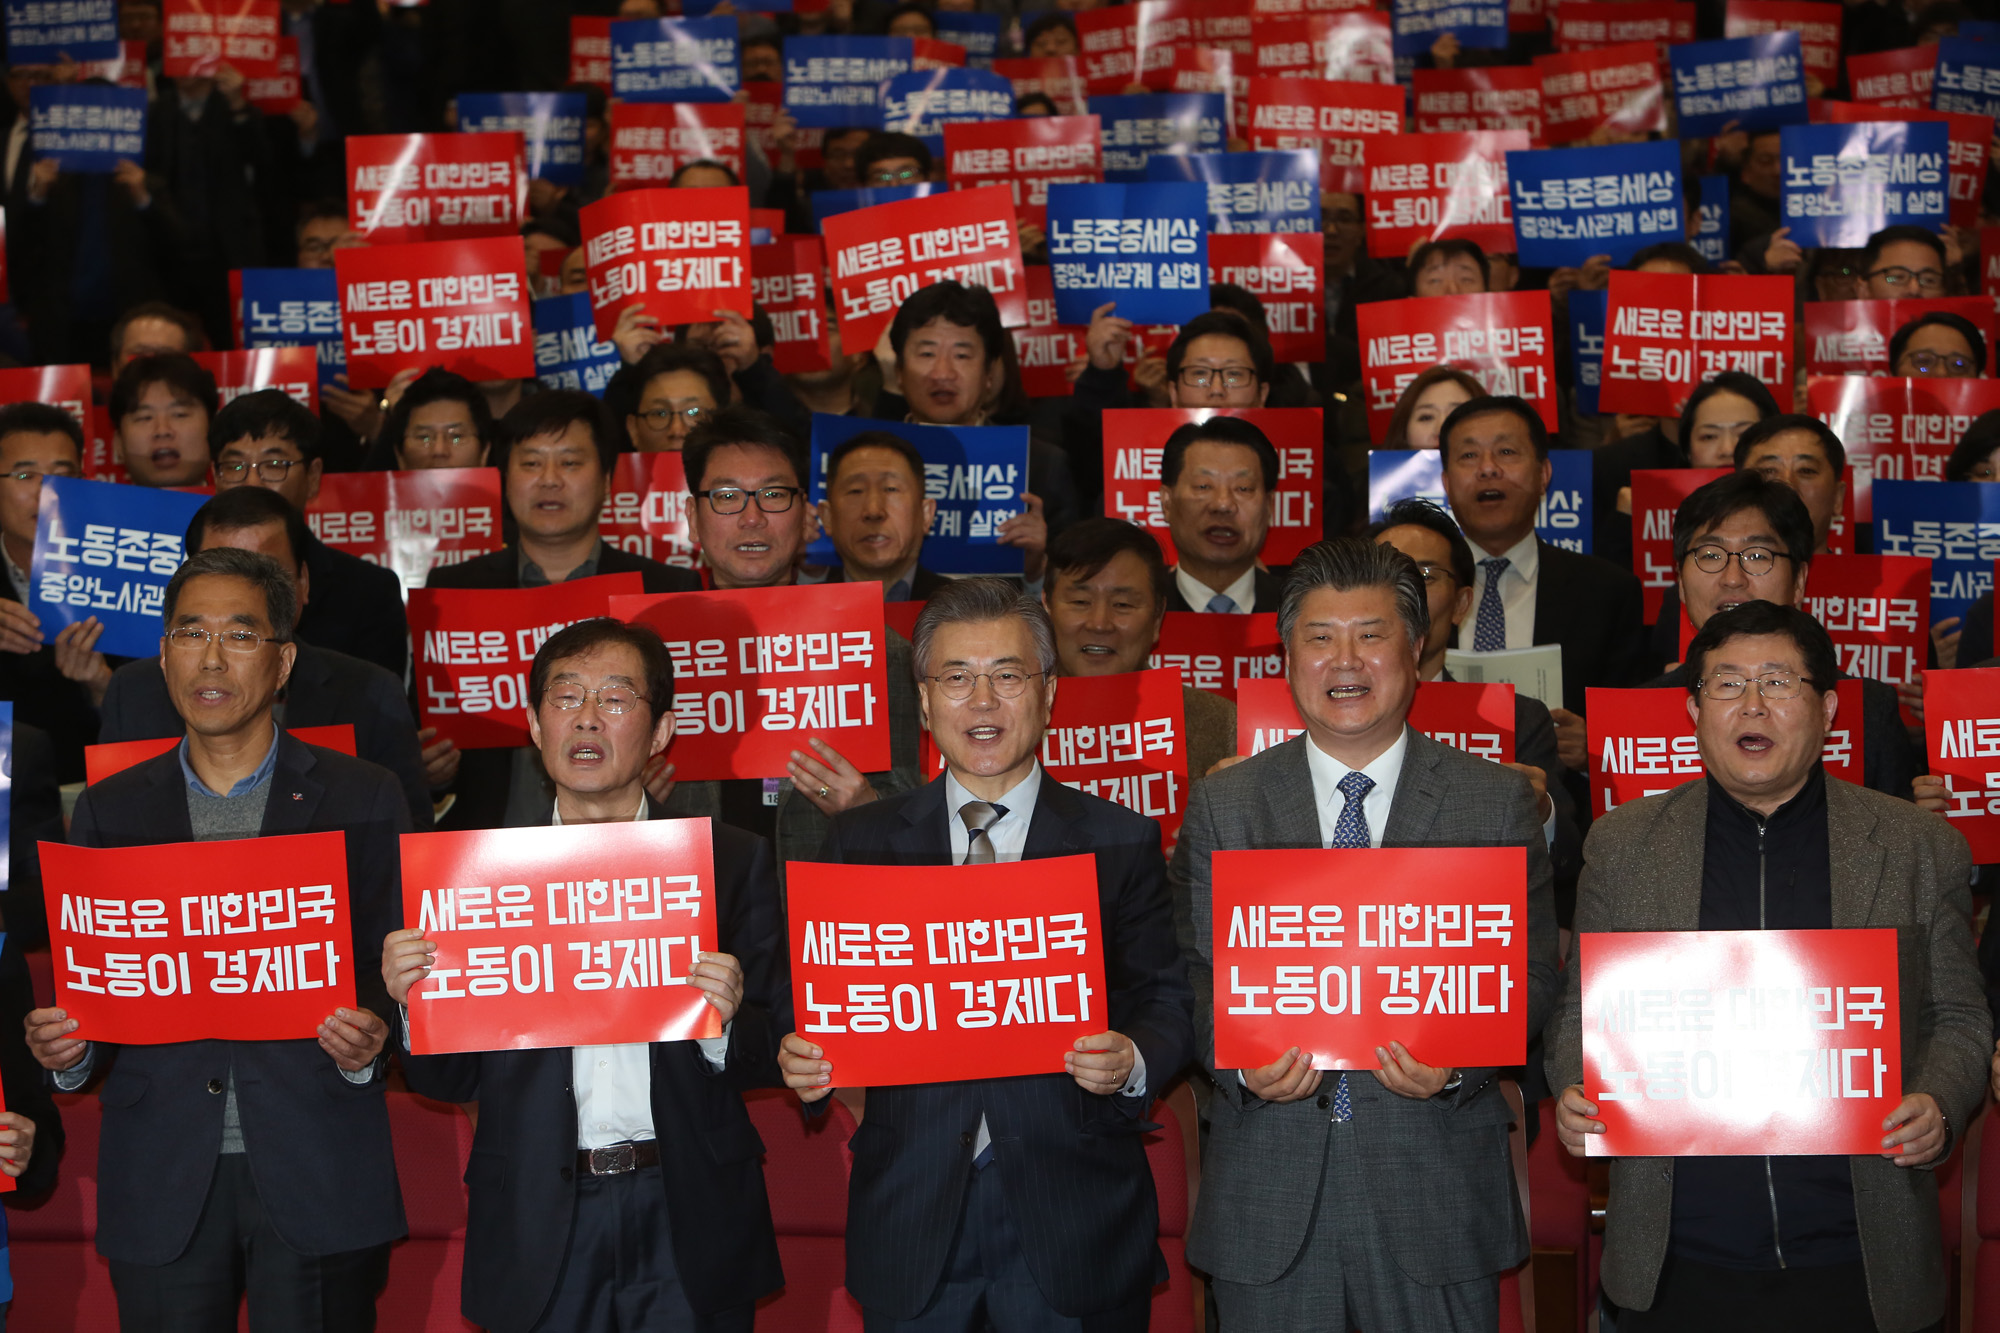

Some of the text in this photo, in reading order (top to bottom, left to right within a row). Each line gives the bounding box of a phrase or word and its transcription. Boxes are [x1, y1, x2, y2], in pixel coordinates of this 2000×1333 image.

[1207, 181, 1312, 215] 존중세상
[1516, 171, 1675, 210] 노동존중세상
[587, 220, 742, 268] 새로운 대한민국
[837, 219, 1010, 279] 새로운 대한민국
[1052, 219, 1200, 254] 노동존중세상
[346, 272, 519, 312] 새로운 대한민국
[592, 256, 743, 309] 노동이 경제다
[751, 272, 816, 305] 한민국
[1053, 262, 1201, 290] 중앙노사관계 실현
[251, 301, 343, 333] 노동존
[350, 319, 426, 355] 노동이
[432, 312, 523, 350] 경제다
[771, 309, 820, 342] 제다
[1262, 302, 1317, 333] 제다
[1613, 306, 1786, 342] 새로운 대한민국
[536, 324, 615, 367] 중세상
[1367, 333, 1438, 367] 새로운
[1444, 326, 1546, 361] 대한민국
[1609, 345, 1692, 384] 노동이
[1902, 414, 1978, 445] 대한민
[924, 464, 1018, 500] 중세상
[1113, 448, 1163, 480] 새로
[384, 506, 493, 541] 대한민국
[1115, 491, 1171, 527] 노동
[44, 520, 188, 576] 노동존중
[1882, 519, 2000, 560] 노동존중
[40, 571, 166, 617] 중앙노사관
[423, 630, 509, 665] 새로운
[667, 631, 874, 679] 로운 대한민국
[1835, 643, 1917, 684] 제다
[427, 673, 528, 714] 노동이
[672, 683, 877, 735] 동이 경제다
[1041, 717, 1175, 767] 대한민국
[1424, 731, 1503, 763] 민국
[1601, 736, 1702, 774] 새로운
[1940, 718, 2000, 758] 새로
[60, 884, 336, 938] 새로운 대한민국
[418, 874, 701, 932] 새로운 대한민국
[802, 912, 1087, 966] 새로운 대한민국
[1227, 903, 1514, 948] 새로운 대한민국
[65, 940, 340, 997] 노동이 경제다
[421, 935, 704, 1000] 노동이 경제다
[804, 972, 1093, 1033] 노동이 경제다
[1228, 964, 1514, 1015] 노동이 경제다
[1597, 988, 1715, 1032] 새로운
[1598, 1049, 1732, 1101] 노동이
